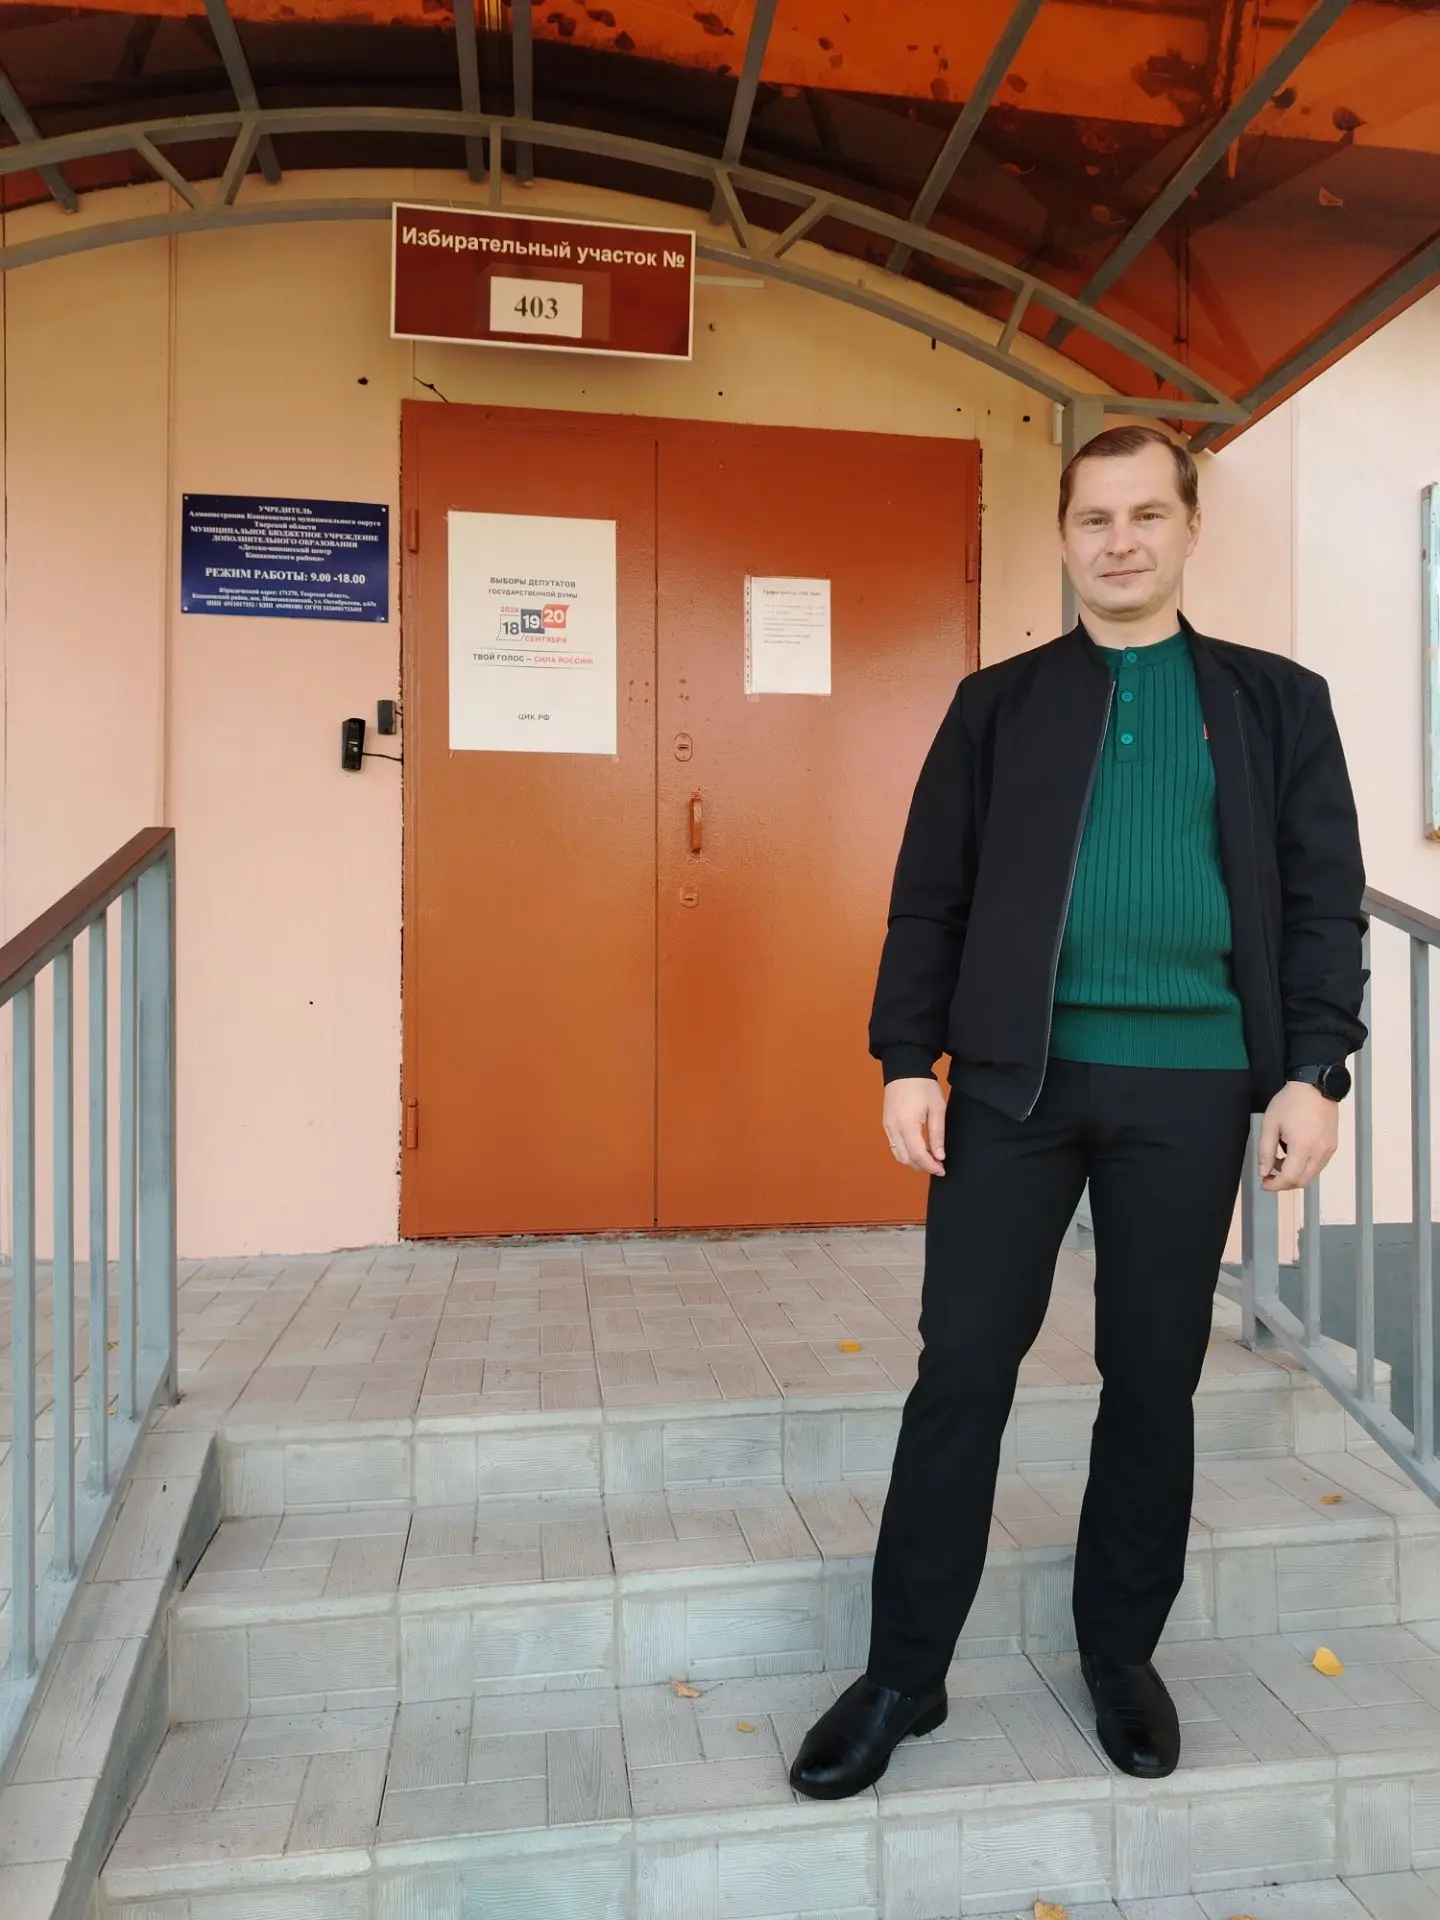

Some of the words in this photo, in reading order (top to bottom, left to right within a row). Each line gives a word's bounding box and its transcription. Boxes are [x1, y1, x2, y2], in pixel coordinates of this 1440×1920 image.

[402, 226, 571, 259] Избирательный
[577, 246, 657, 267] участок
[663, 250, 686, 269] №
[514, 295, 559, 320] 403
[259, 505, 312, 514] УЧРЕДИТЕЛЬ
[254, 521, 288, 529] Тверской
[289, 523, 316, 531] области
[190, 526, 267, 536] МУНИЦИПАЛЬНОЕ
[268, 529, 322, 538] БЮДЖЕТНОЕ
[323, 532, 379, 542] УЧРЕЖДЕНИЕ
[211, 535, 297, 545] ДОПОЛНИТЕЛЬНОГО
[298, 539, 358, 549] ОБРАЗОВАНИЯ
[205, 567, 251, 578] РЕЖИМ
[254, 569, 308, 581] РАБОТЫ:
[310, 572, 331, 583] 9.00
[490, 577, 526, 585] ВЫБОРЫ
[528, 579, 576, 588] ДЕПУТАТОВ
[488, 588, 555, 598] ГОСУДАРСТВЕННОЙ
[502, 621, 519, 635] 18
[523, 614, 541, 629] 19
[544, 609, 564, 624] 20
[524, 635, 567, 644] СЕНТЯБРЯ
[473, 652, 496, 661] ТВОЙ
[497, 654, 524, 662] ГОЛОС
